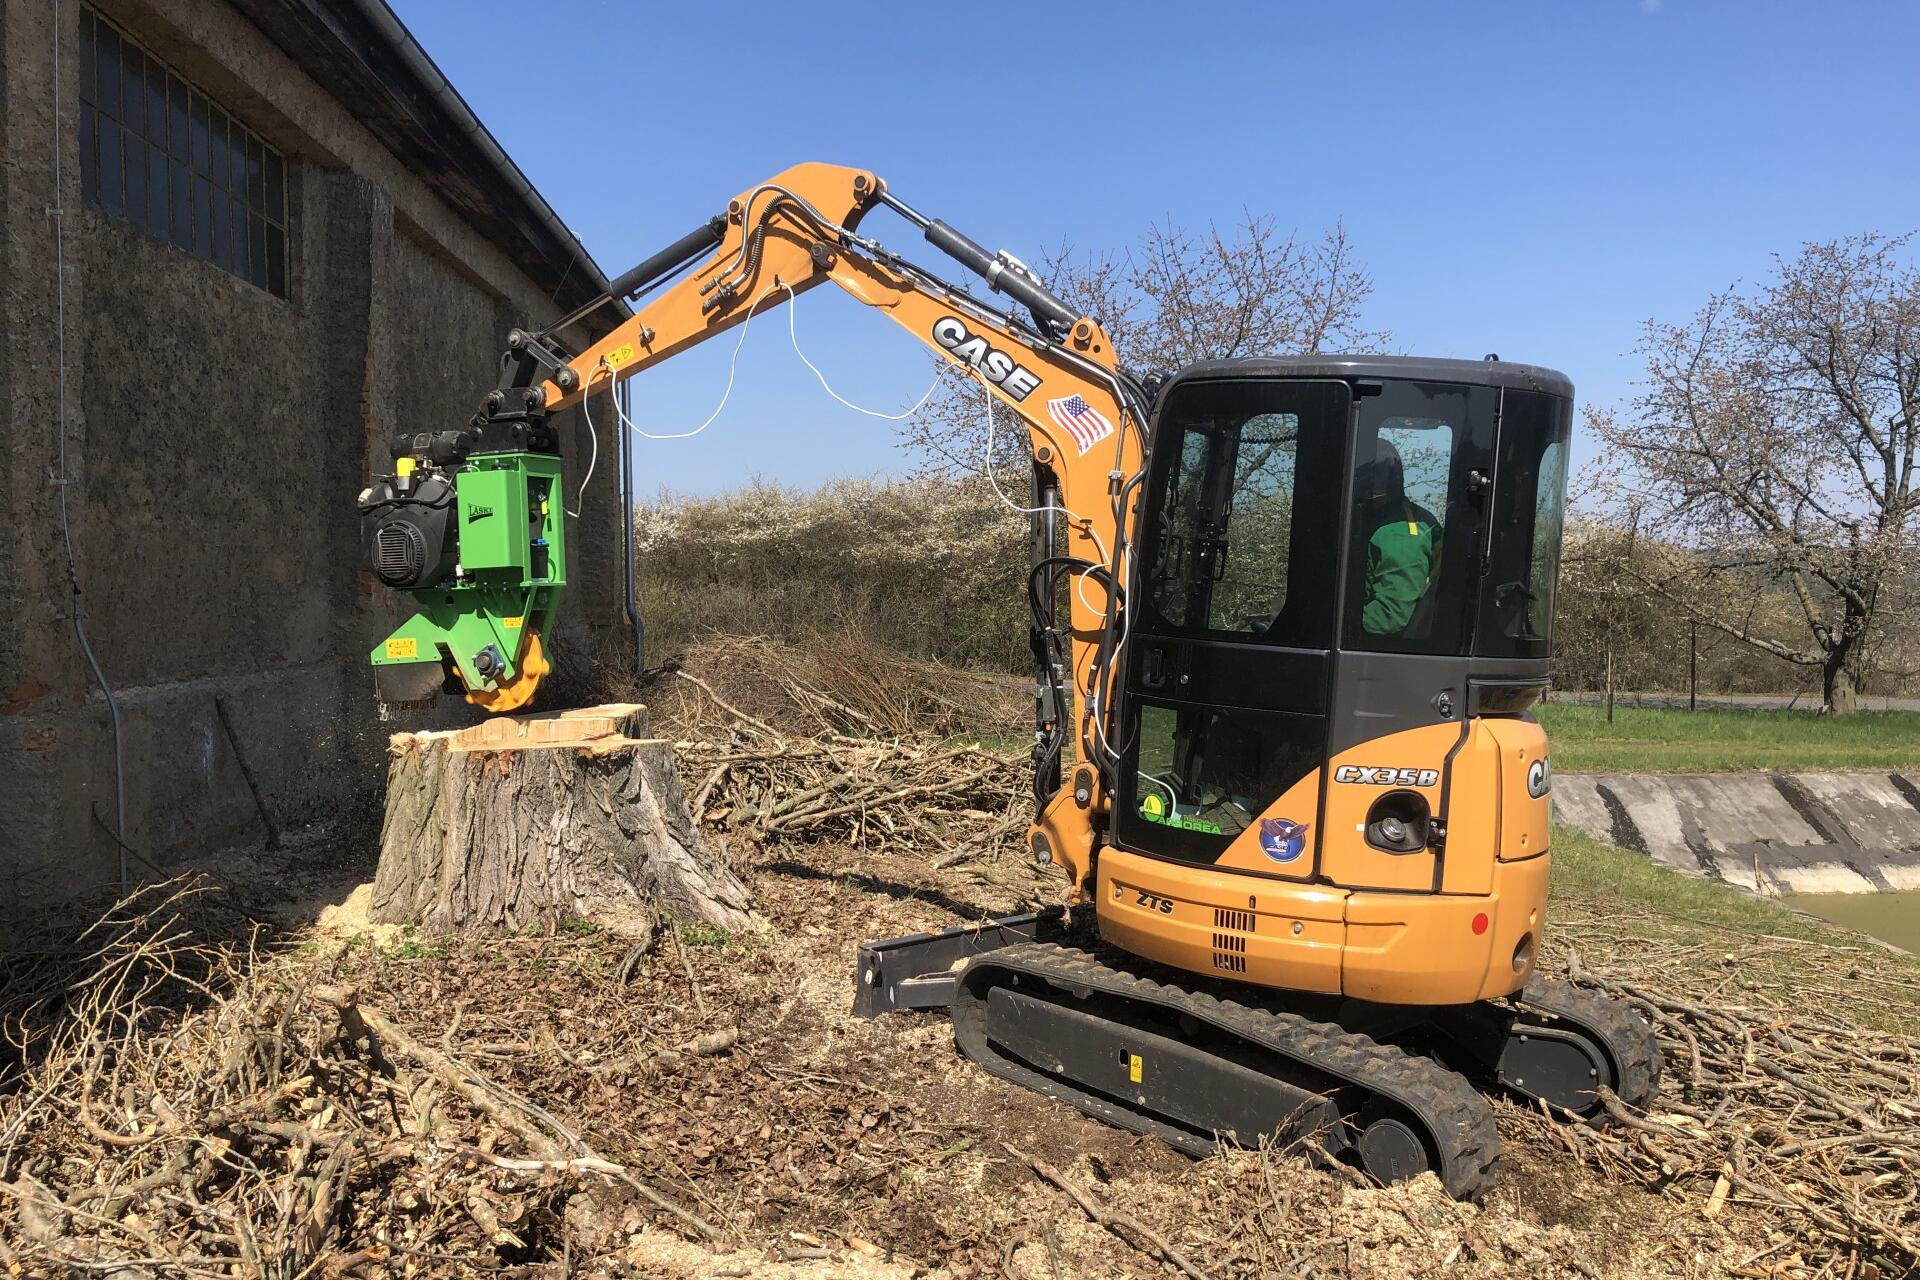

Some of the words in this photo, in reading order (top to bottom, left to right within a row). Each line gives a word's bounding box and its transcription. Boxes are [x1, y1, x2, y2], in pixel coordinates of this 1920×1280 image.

[933, 316, 1043, 402] CASE
[1334, 765, 1439, 787] CX35B
[1527, 756, 1551, 799] CA
[1158, 816, 1221, 835] ARBOREA
[1136, 891, 1173, 913] ZTS
